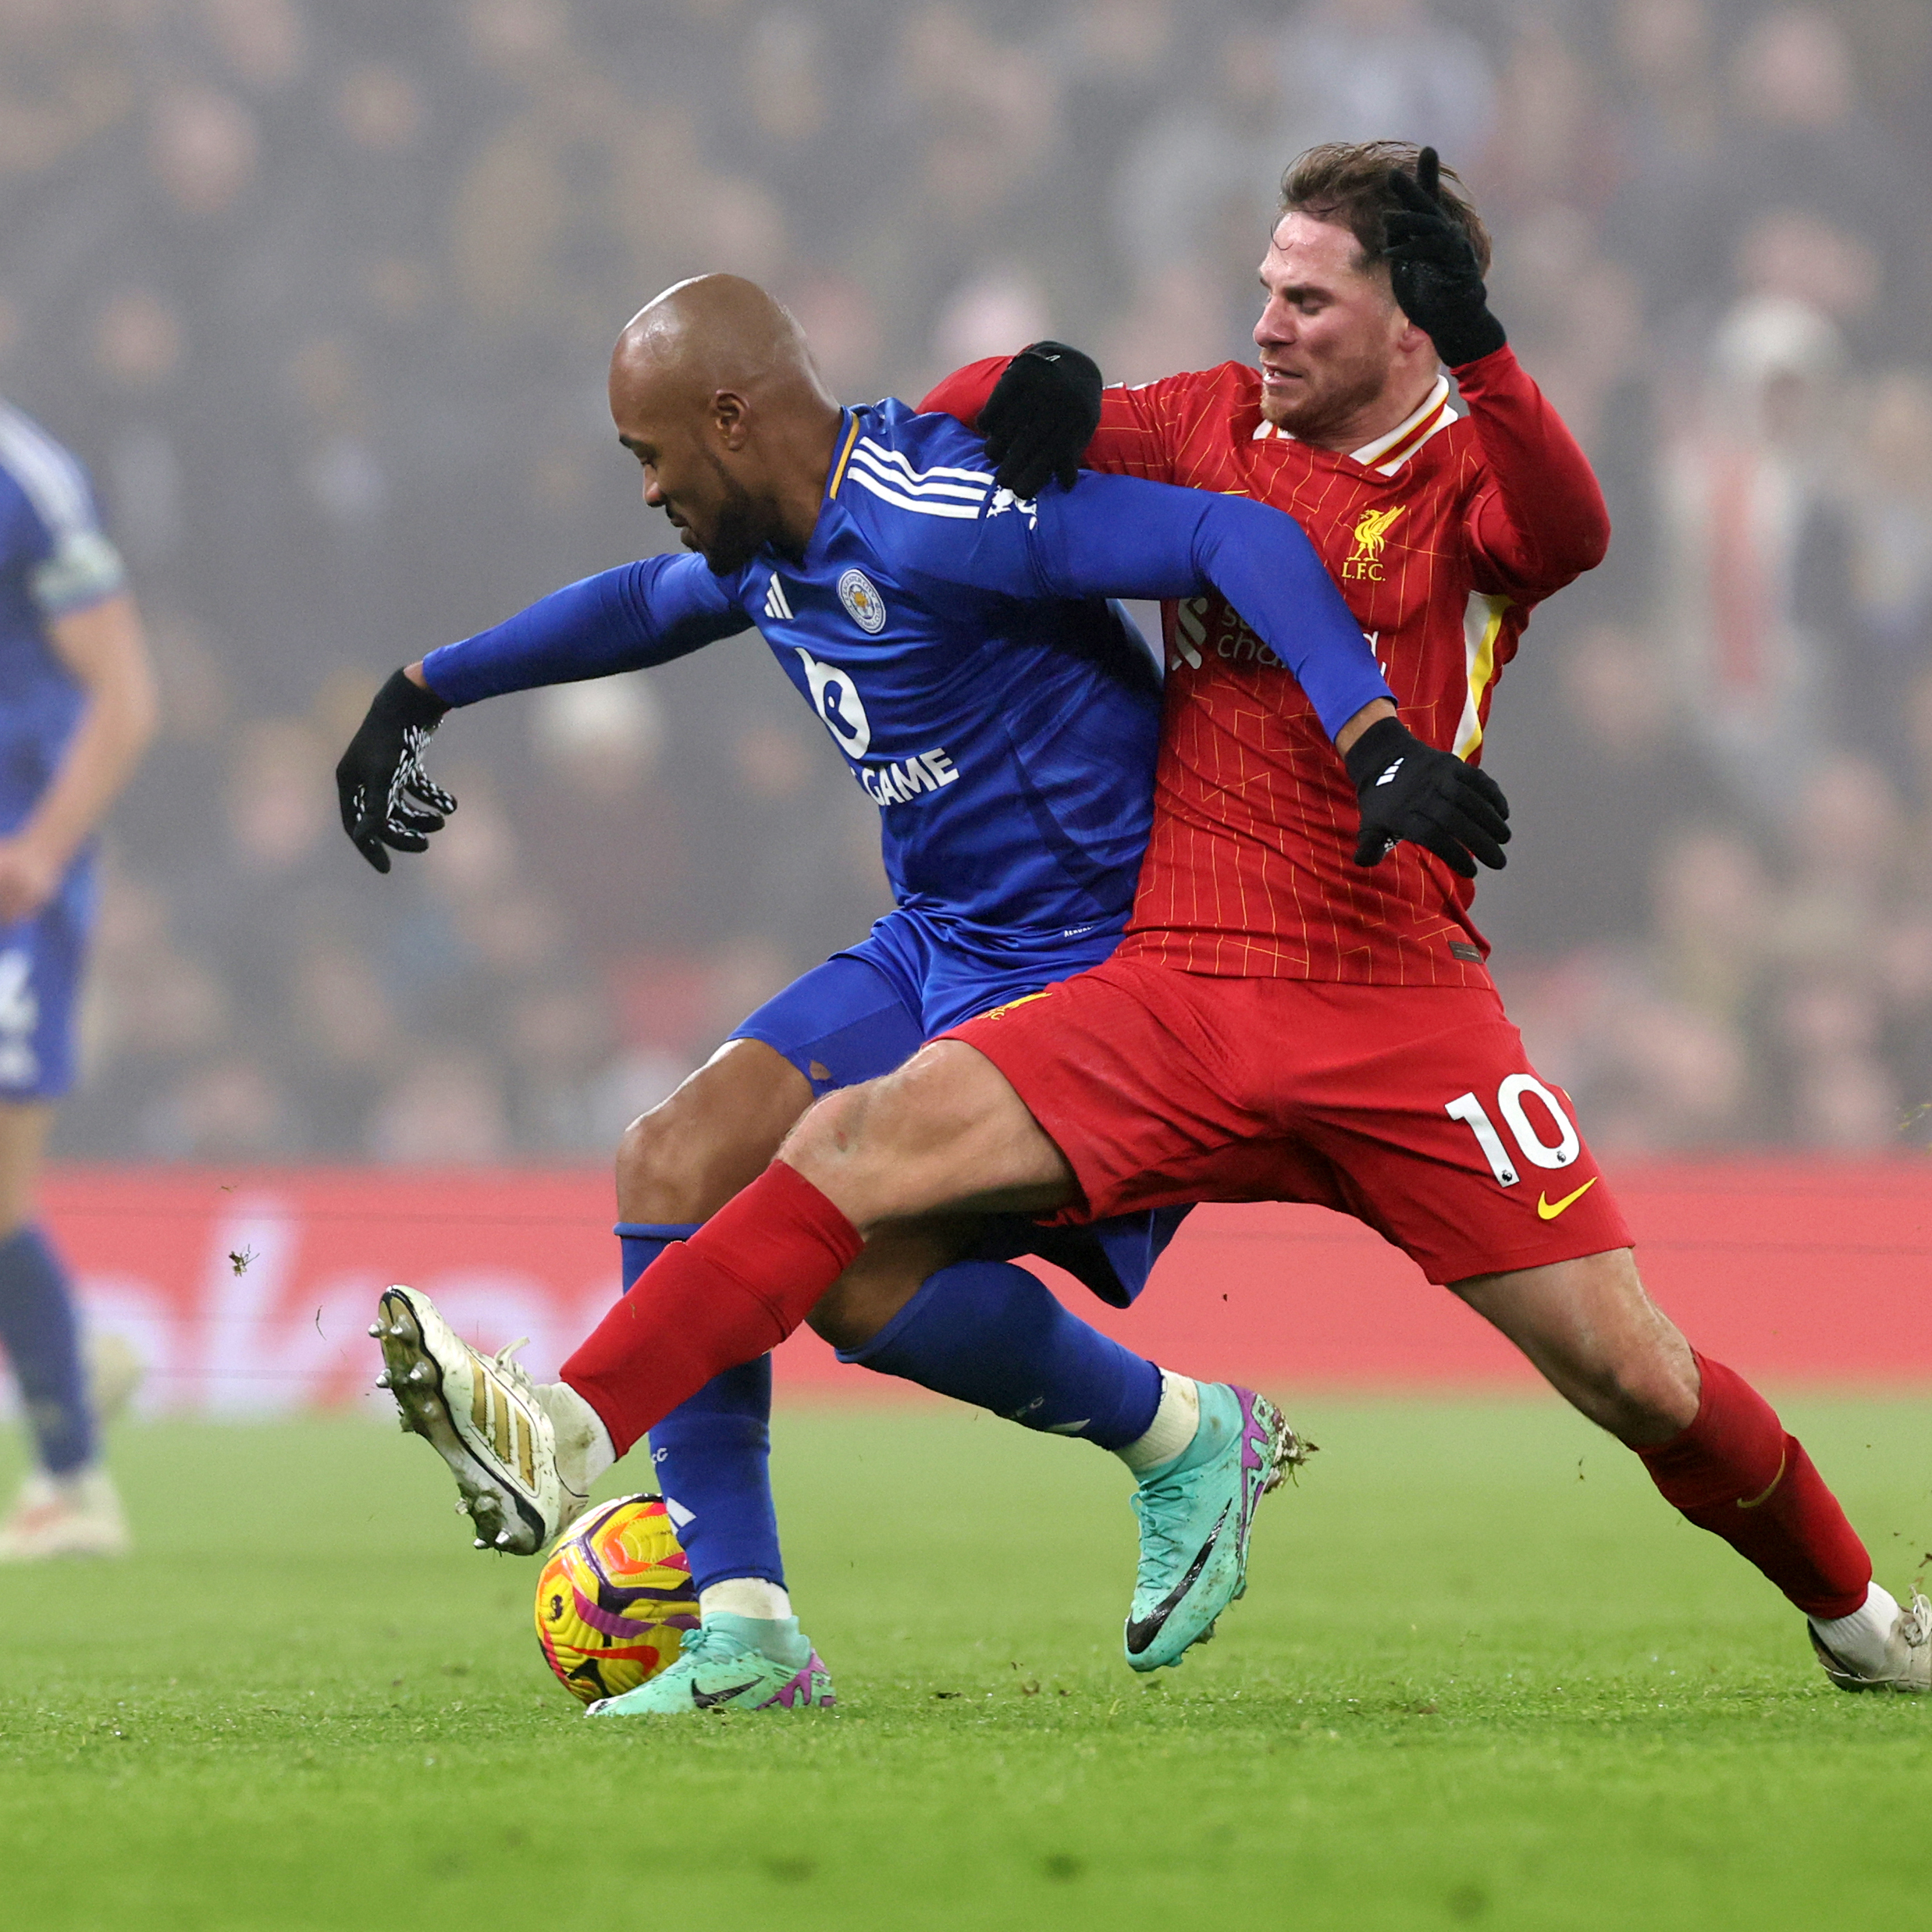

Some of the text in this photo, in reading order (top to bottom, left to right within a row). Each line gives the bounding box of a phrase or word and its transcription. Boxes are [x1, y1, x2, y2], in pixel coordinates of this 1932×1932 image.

[1342, 561, 1386, 582] L.F.C.
[850, 747, 959, 806] GAME
[1444, 1073, 1580, 1188] 10
